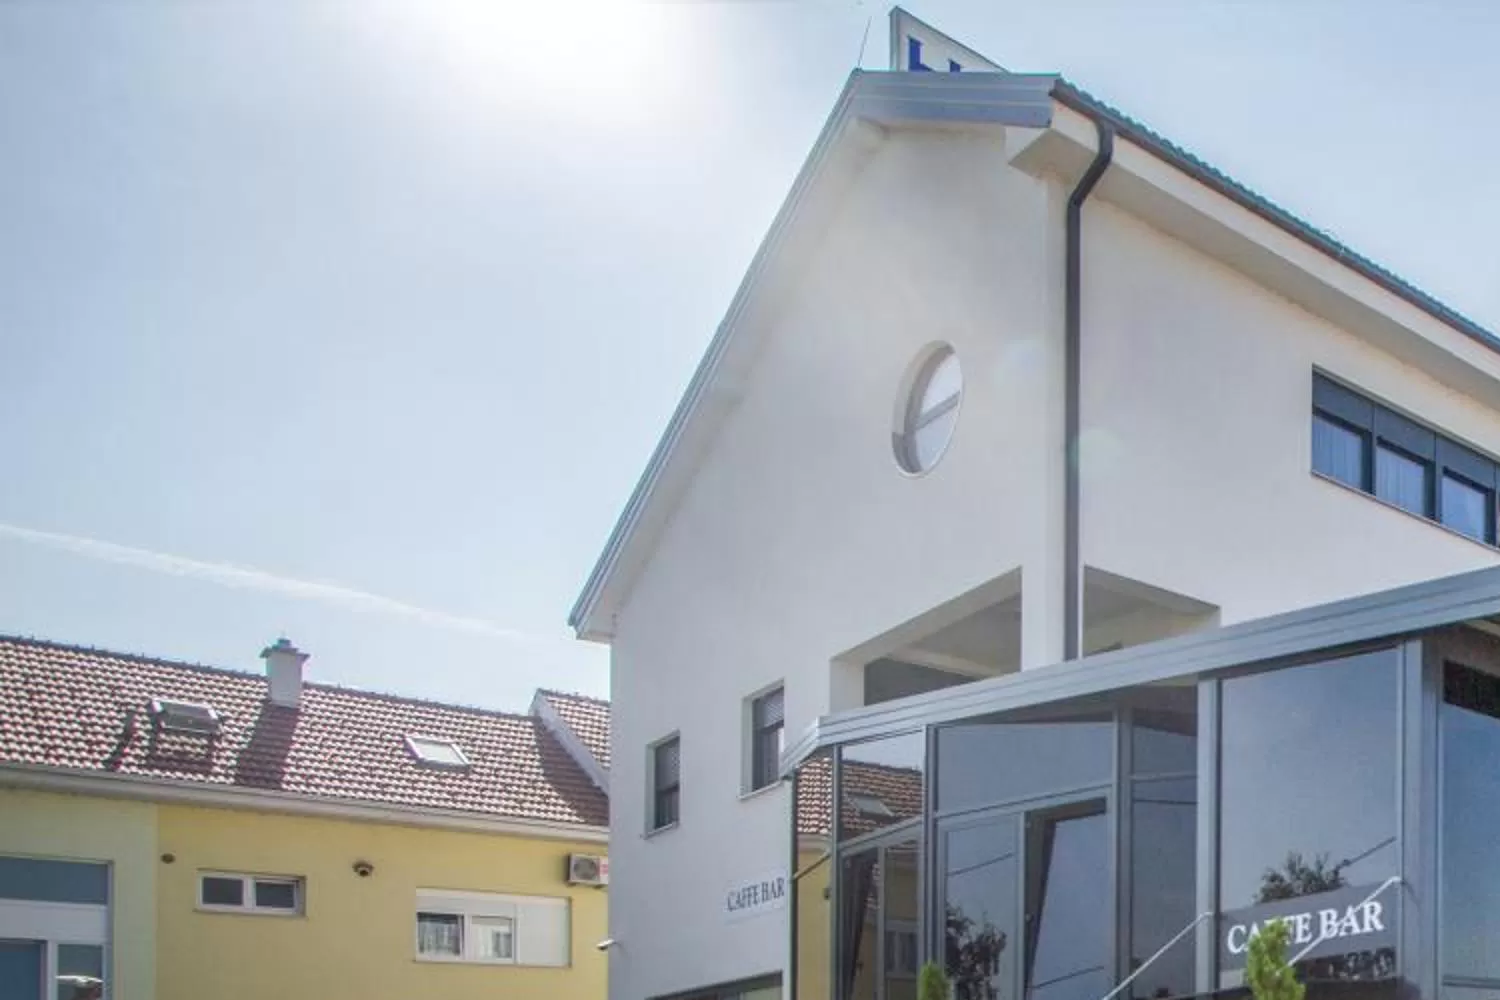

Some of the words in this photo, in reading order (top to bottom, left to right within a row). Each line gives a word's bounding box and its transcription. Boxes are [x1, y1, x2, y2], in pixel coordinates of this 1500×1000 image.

[726, 884, 759, 912] CAFFE
[761, 877, 785, 904] BAR
[1227, 911, 1313, 954] CAE
[1318, 901, 1385, 939] BAR
